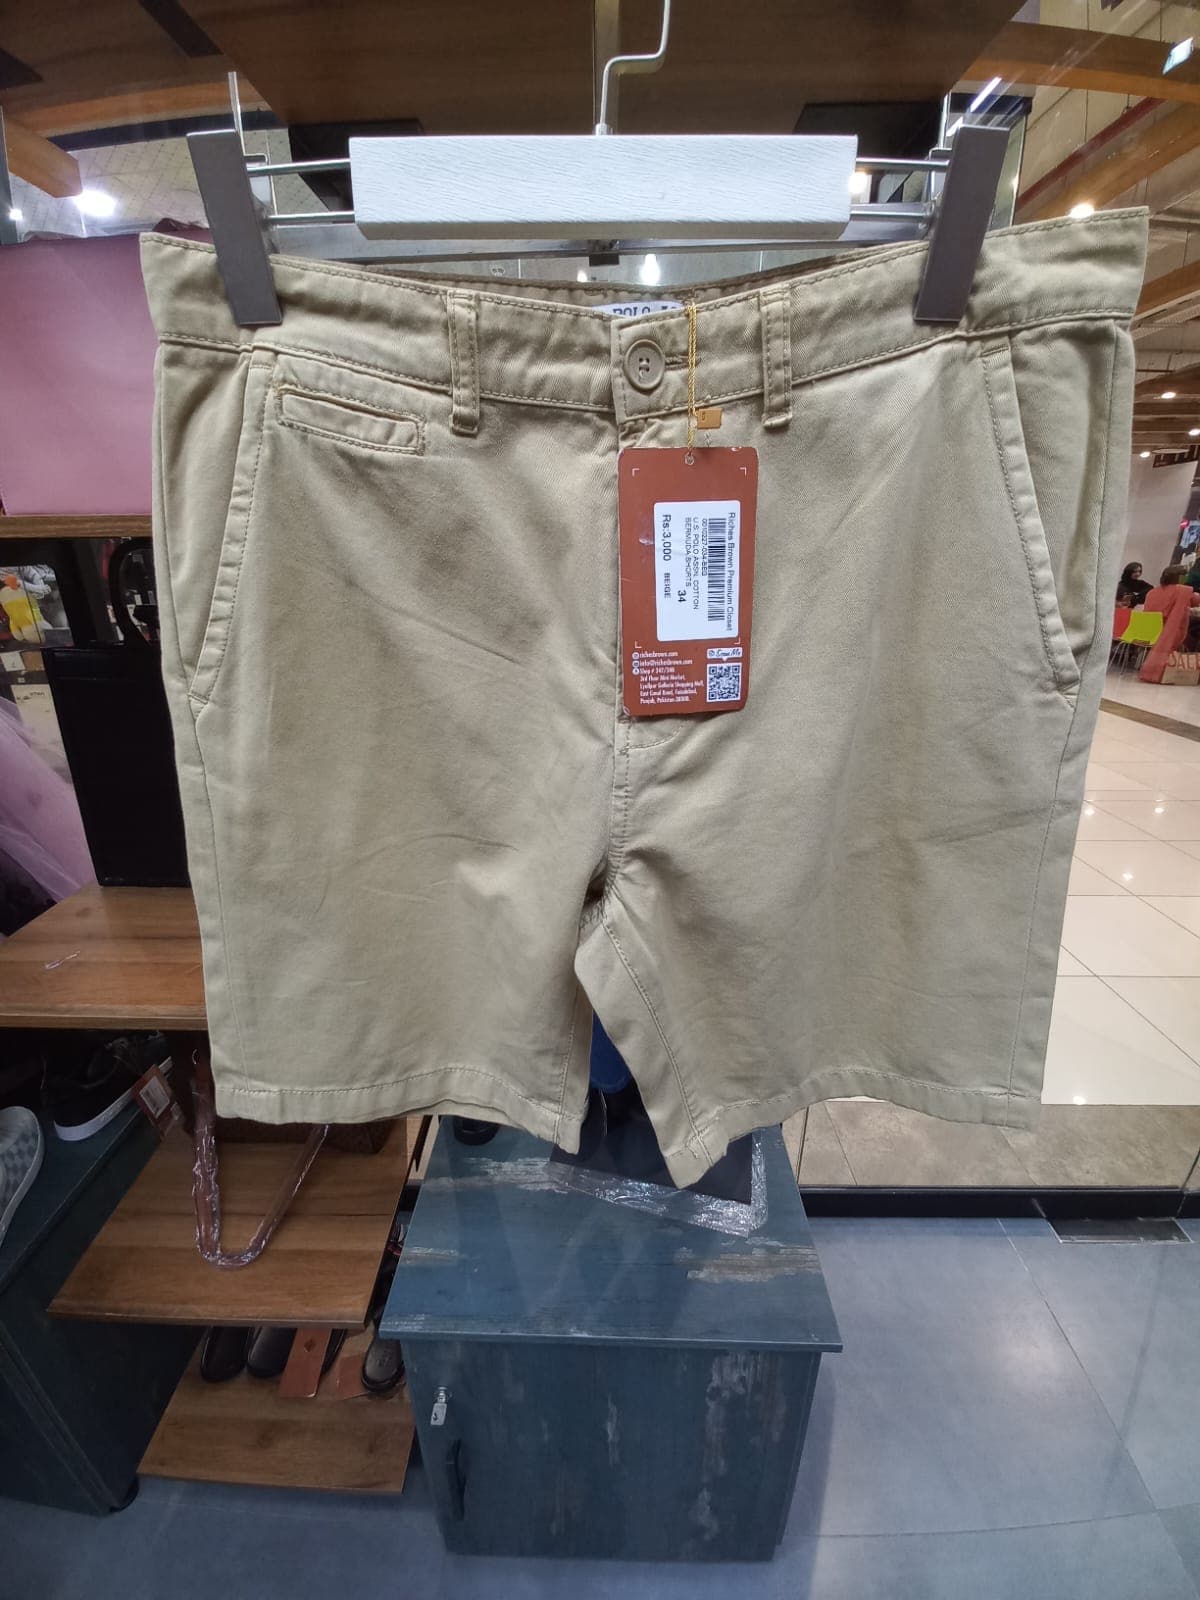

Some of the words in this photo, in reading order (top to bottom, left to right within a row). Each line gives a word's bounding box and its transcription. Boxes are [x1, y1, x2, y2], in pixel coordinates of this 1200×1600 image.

[661, 514, 672, 562] Rs:3,000
[727, 512, 736, 541] Riches
[726, 542, 735, 569] Brown
[663, 572, 671, 599] BEIGE
[677, 589, 687, 603] 34
[726, 570, 735, 605] Premium
[726, 606, 734, 632] Closet
